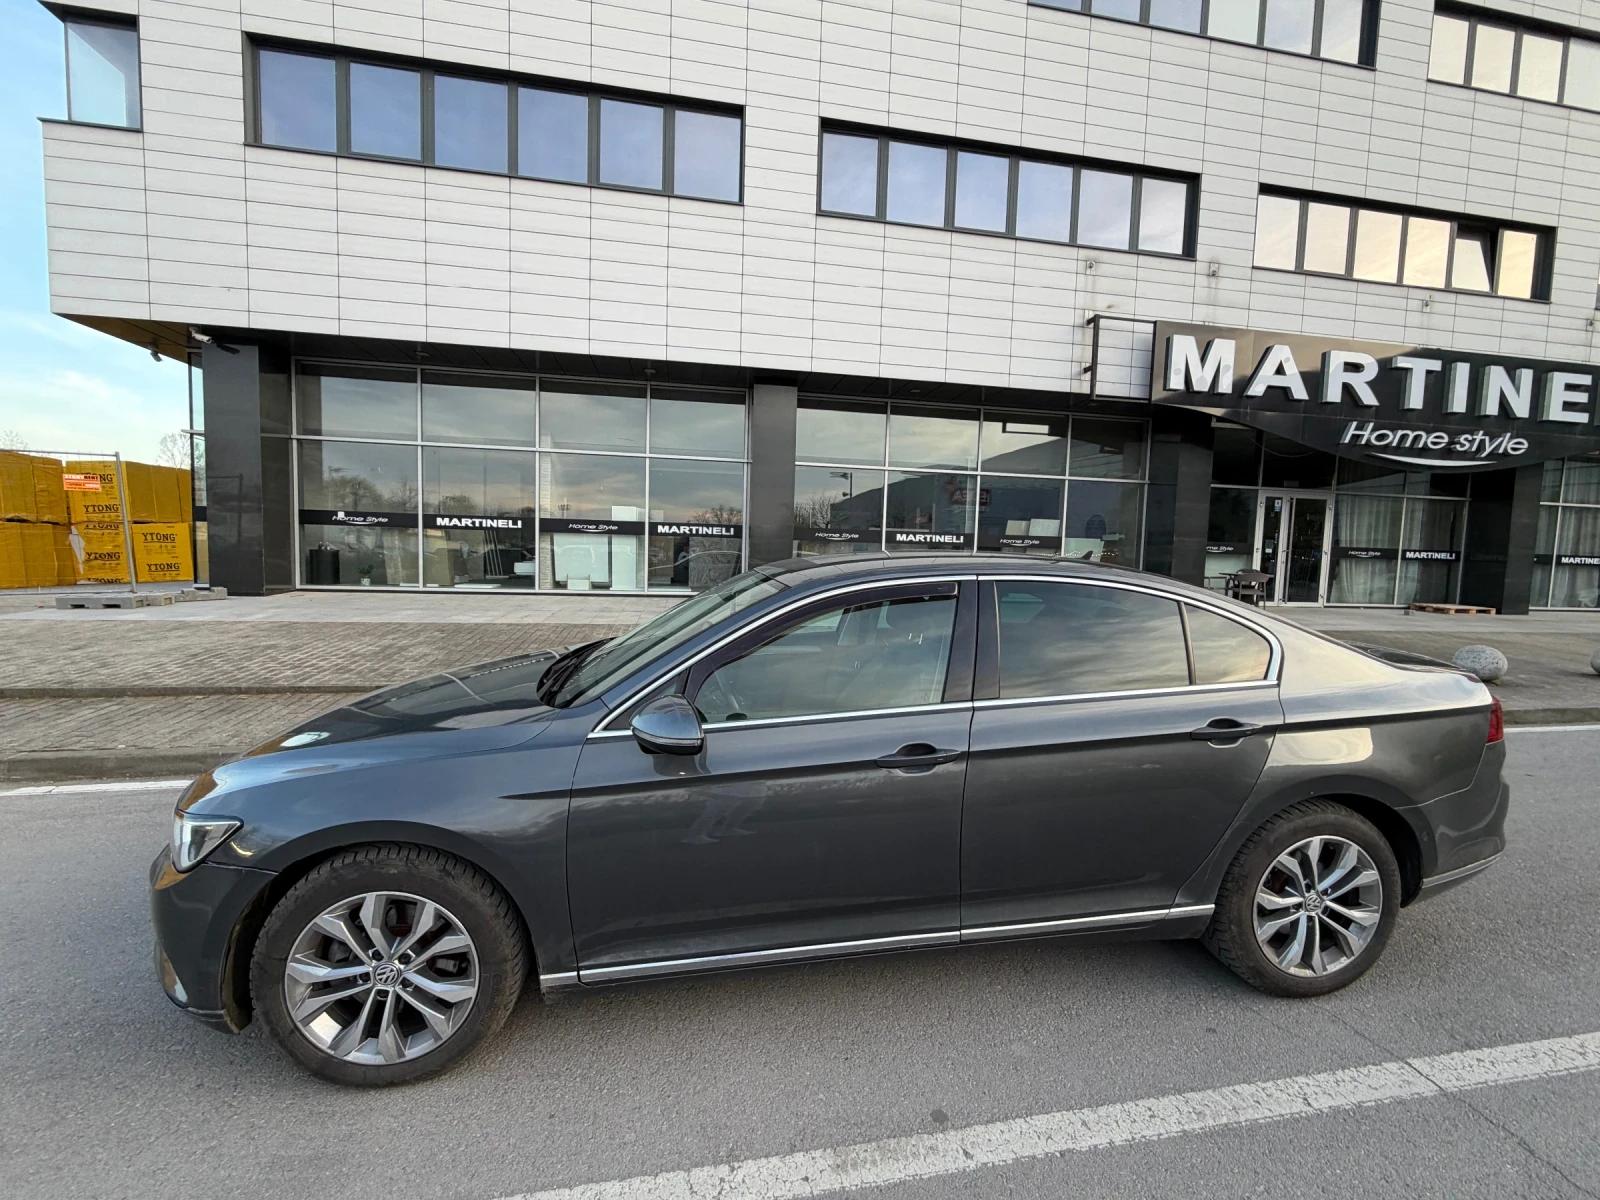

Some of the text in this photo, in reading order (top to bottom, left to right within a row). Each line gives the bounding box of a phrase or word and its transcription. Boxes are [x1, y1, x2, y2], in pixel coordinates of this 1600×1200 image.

[1166, 333, 1600, 425] MARTINE
[1340, 420, 1530, 458] Home style
[83, 503, 119, 513] YTONG
[332, 514, 389, 524] Home Style
[436, 517, 522, 529] MARTINELI
[657, 524, 735, 536] MARTINELI
[141, 532, 176, 542] YTONG
[896, 533, 964, 543] MARTINELI
[85, 551, 121, 560] YTONG
[1405, 551, 1456, 560] MARTINELI
[146, 563, 180, 571] YTONG
